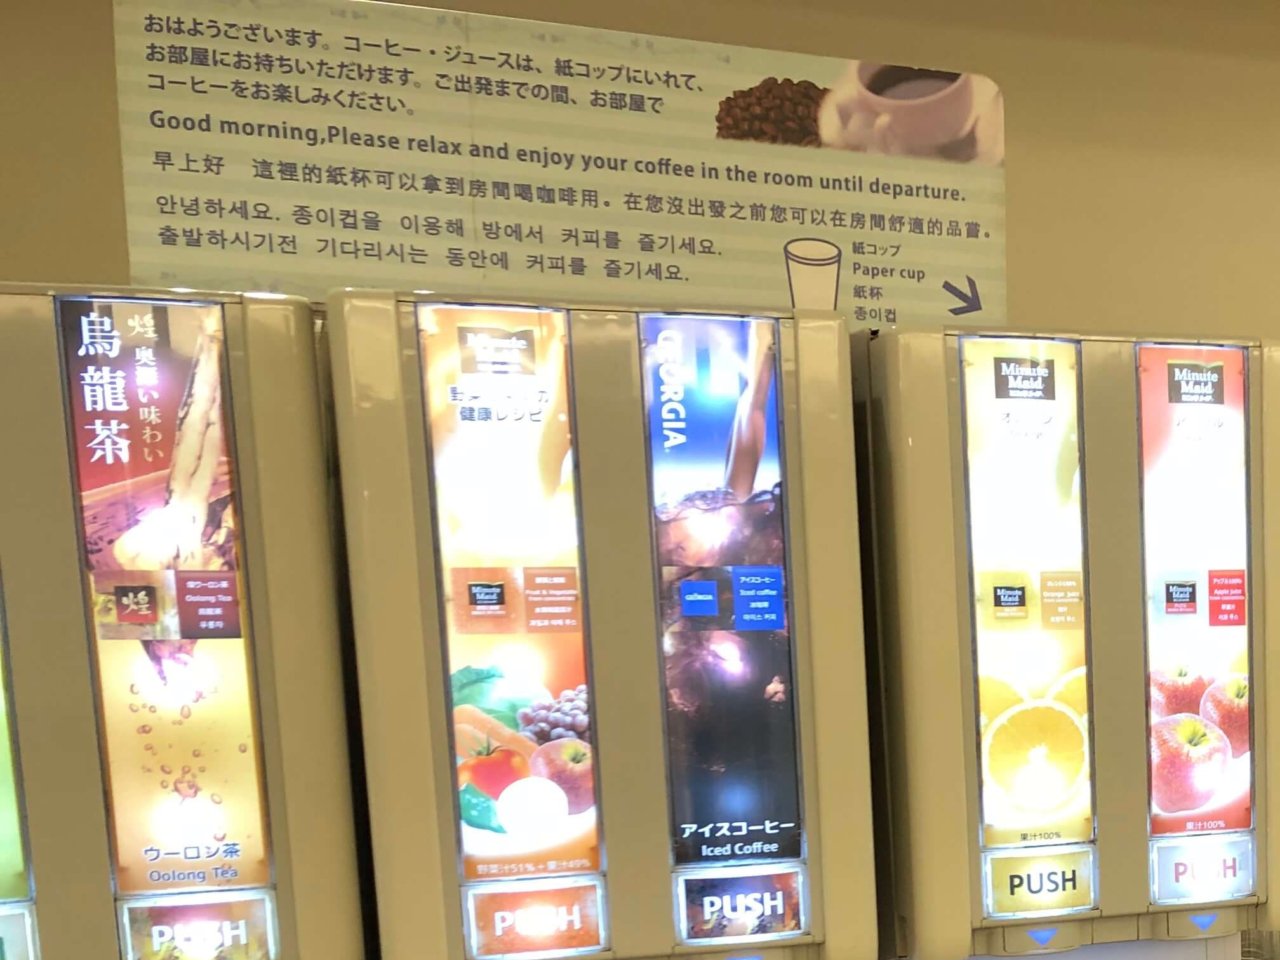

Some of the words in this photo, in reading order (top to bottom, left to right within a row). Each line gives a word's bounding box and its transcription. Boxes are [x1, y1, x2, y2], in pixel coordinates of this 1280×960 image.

[148, 74, 414, 116] コーヒーをお楽しみください。
[149, 110, 211, 132] Good
[219, 119, 400, 150] morning,Please
[408, 135, 462, 155] relax
[469, 142, 509, 160] and
[516, 147, 575, 170] enjoy
[581, 153, 628, 171] your
[634, 158, 695, 177] coffee
[701, 162, 719, 180] in
[725, 165, 757, 183] the
[763, 171, 813, 188] room
[819, 175, 863, 192] until
[869, 178, 966, 201] departure.
[152, 150, 225, 175] 早上好
[156, 194, 280, 221] 안녕하세요.
[291, 204, 382, 231] 종이컵을
[400, 214, 465, 237] 이용해
[482, 220, 544, 244] 방에서
[561, 227, 622, 250] 커피를
[637, 232, 722, 256] 즐기세요.
[158, 225, 297, 255] 출발하시기전
[317, 237, 428, 264] 기다리시는
[446, 247, 509, 270] 동안에
[526, 253, 587, 276] 커피를
[603, 259, 690, 281] 즐기세요.
[852, 241, 902, 257] 紙コップ
[852, 262, 895, 280] Paper
[899, 267, 926, 282] cup
[853, 284, 883, 300] 紙杯
[853, 306, 897, 323] 종이컵
[1000, 361, 1049, 377] Minute
[1174, 367, 1219, 382] Minute
[77, 311, 131, 465] 烏龍茶
[657, 329, 687, 449] GORGIA
[1180, 380, 1215, 395] Maid
[681, 820, 795, 838] アイスコーヒー
[1186, 819, 1226, 831] 果汁100%
[1020, 830, 1062, 842] 果汁100%
[143, 843, 241, 862] ウーロン茶
[701, 843, 731, 857] Iced
[734, 841, 779, 856] Coffee
[148, 869, 206, 883] Oolong
[212, 867, 239, 879] Tea
[1174, 857, 1238, 884] PH
[1008, 869, 1078, 896] PUSH
[702, 890, 785, 921] PUSH
[494, 903, 582, 937] PH
[151, 919, 248, 952] PH
